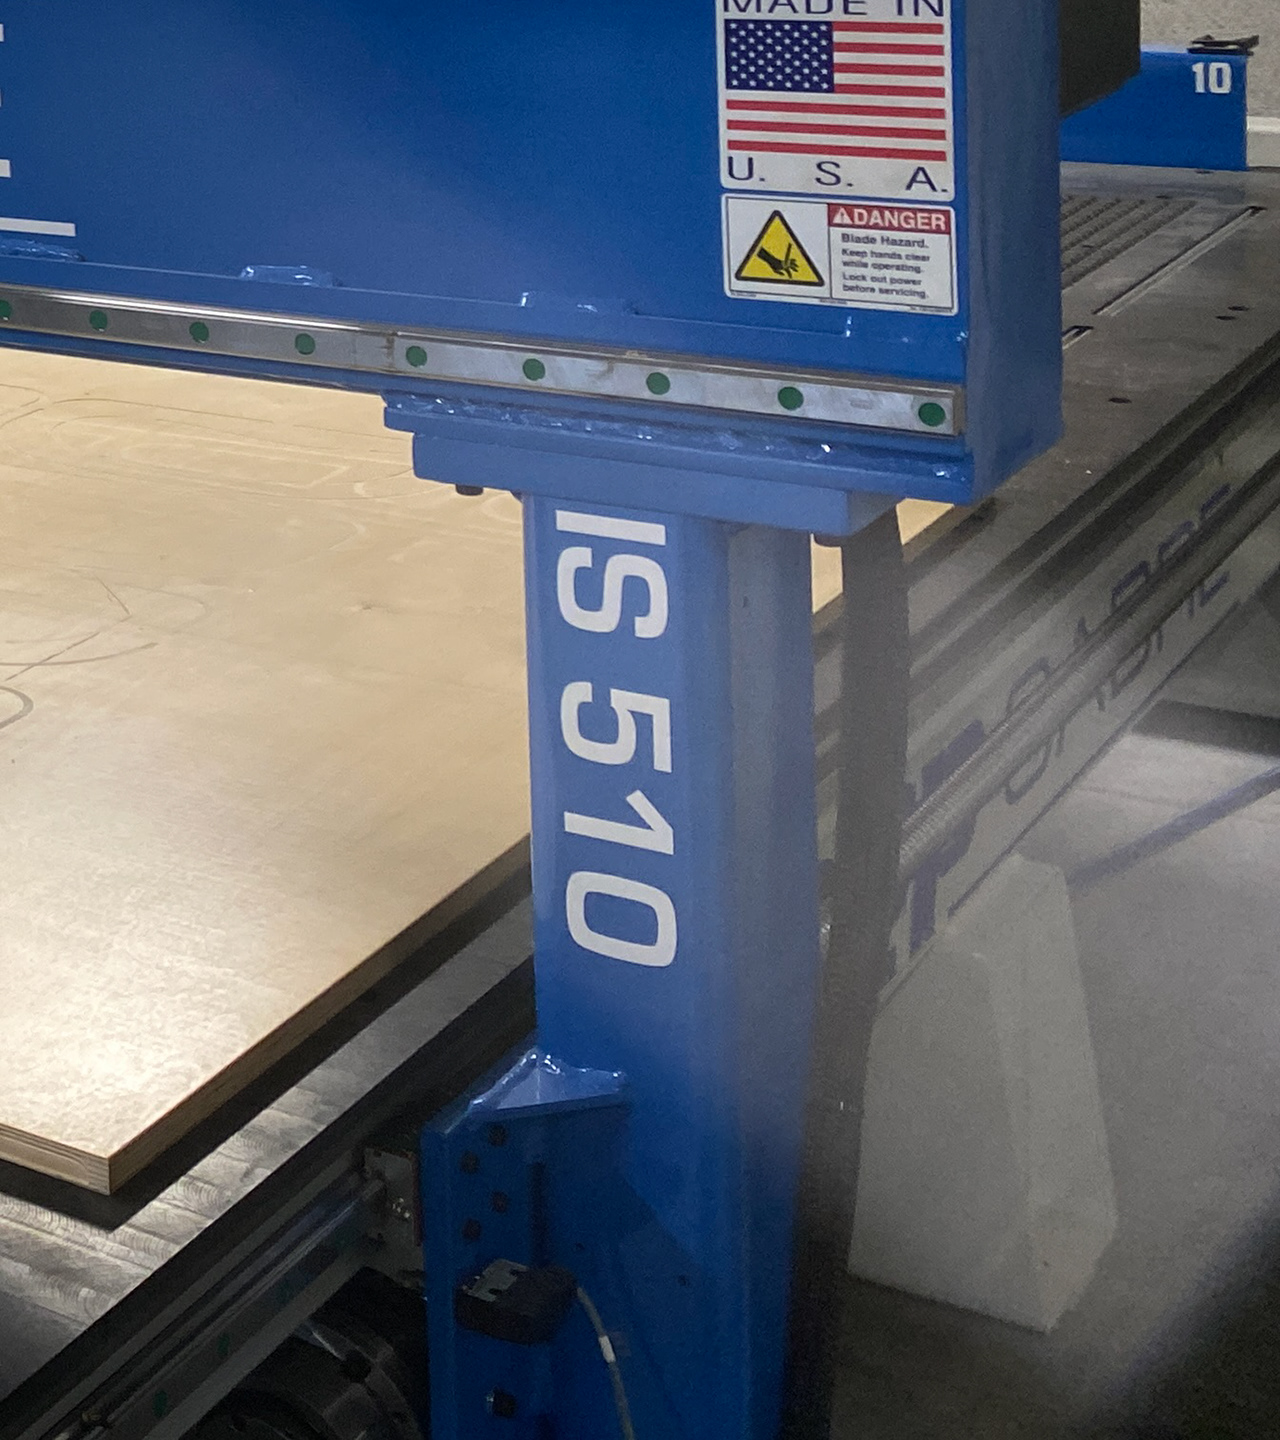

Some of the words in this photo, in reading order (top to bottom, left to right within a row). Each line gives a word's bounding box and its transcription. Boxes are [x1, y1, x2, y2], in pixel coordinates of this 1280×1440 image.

[1192, 61, 1232, 94] 10
[853, 208, 947, 231] DANGER
[841, 233, 878, 245] Blade
[880, 235, 930, 249] Hazard.
[841, 248, 868, 259] Keep
[870, 249, 903, 260] hands
[905, 252, 931, 262] clear
[842, 259, 869, 269] while
[842, 272, 867, 282] Lock
[870, 275, 887, 283] out
[889, 277, 922, 287] power
[842, 284, 876, 294] before
[555, 509, 669, 639] IS
[560, 681, 678, 968] 510
